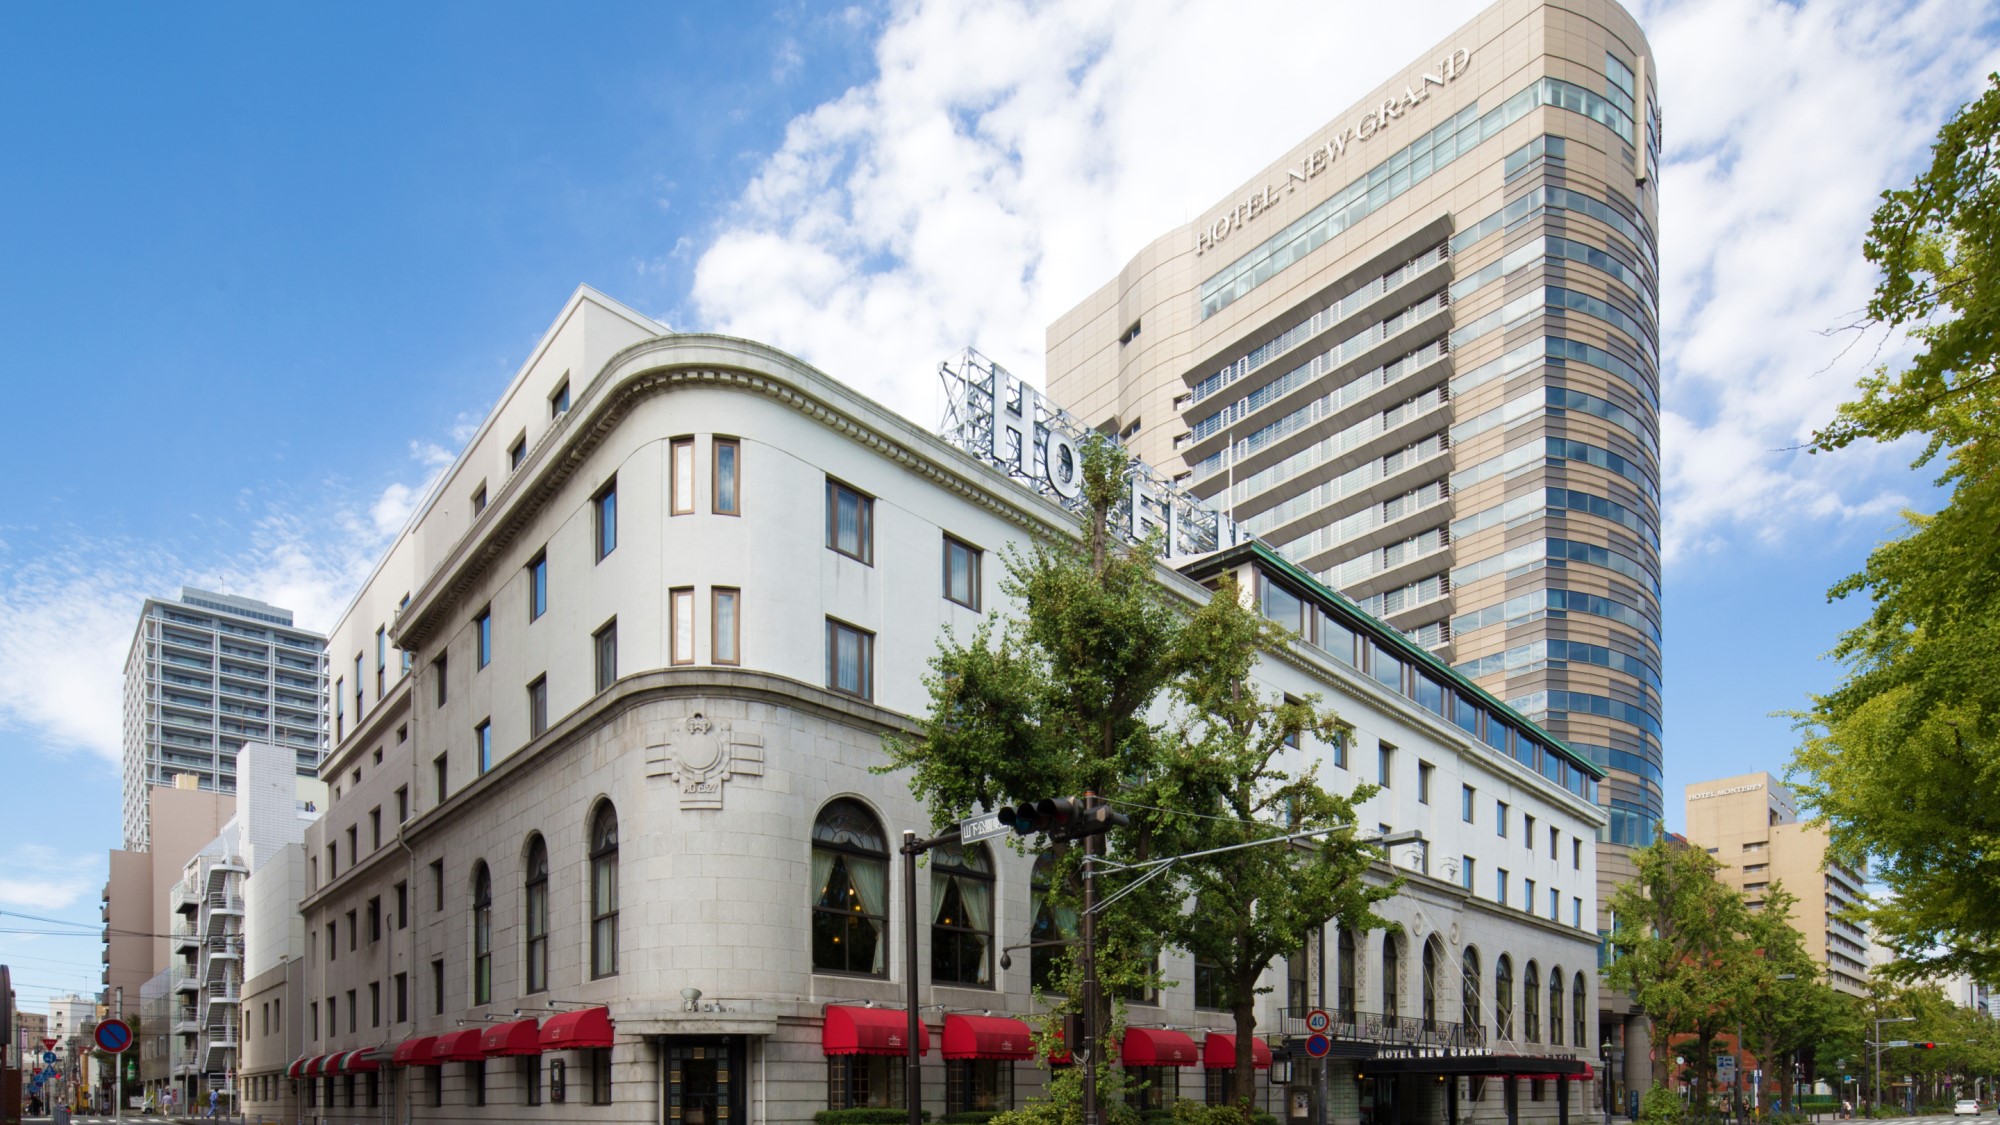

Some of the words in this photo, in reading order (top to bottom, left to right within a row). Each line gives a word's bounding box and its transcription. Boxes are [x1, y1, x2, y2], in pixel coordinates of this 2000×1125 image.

[1196, 184, 1279, 256] HOTEL
[1286, 127, 1351, 193] NEW
[1356, 47, 1471, 141] GRAND
[992, 363, 1189, 557] HOEL
[1689, 790, 1716, 801] HOTEL
[1717, 783, 1764, 796] MONTEREY
[1311, 1016, 1325, 1027] 40
[1377, 1049, 1414, 1059] HOTEL
[1419, 1048, 1446, 1058] NEW
[1450, 1047, 1493, 1057] GRAND
